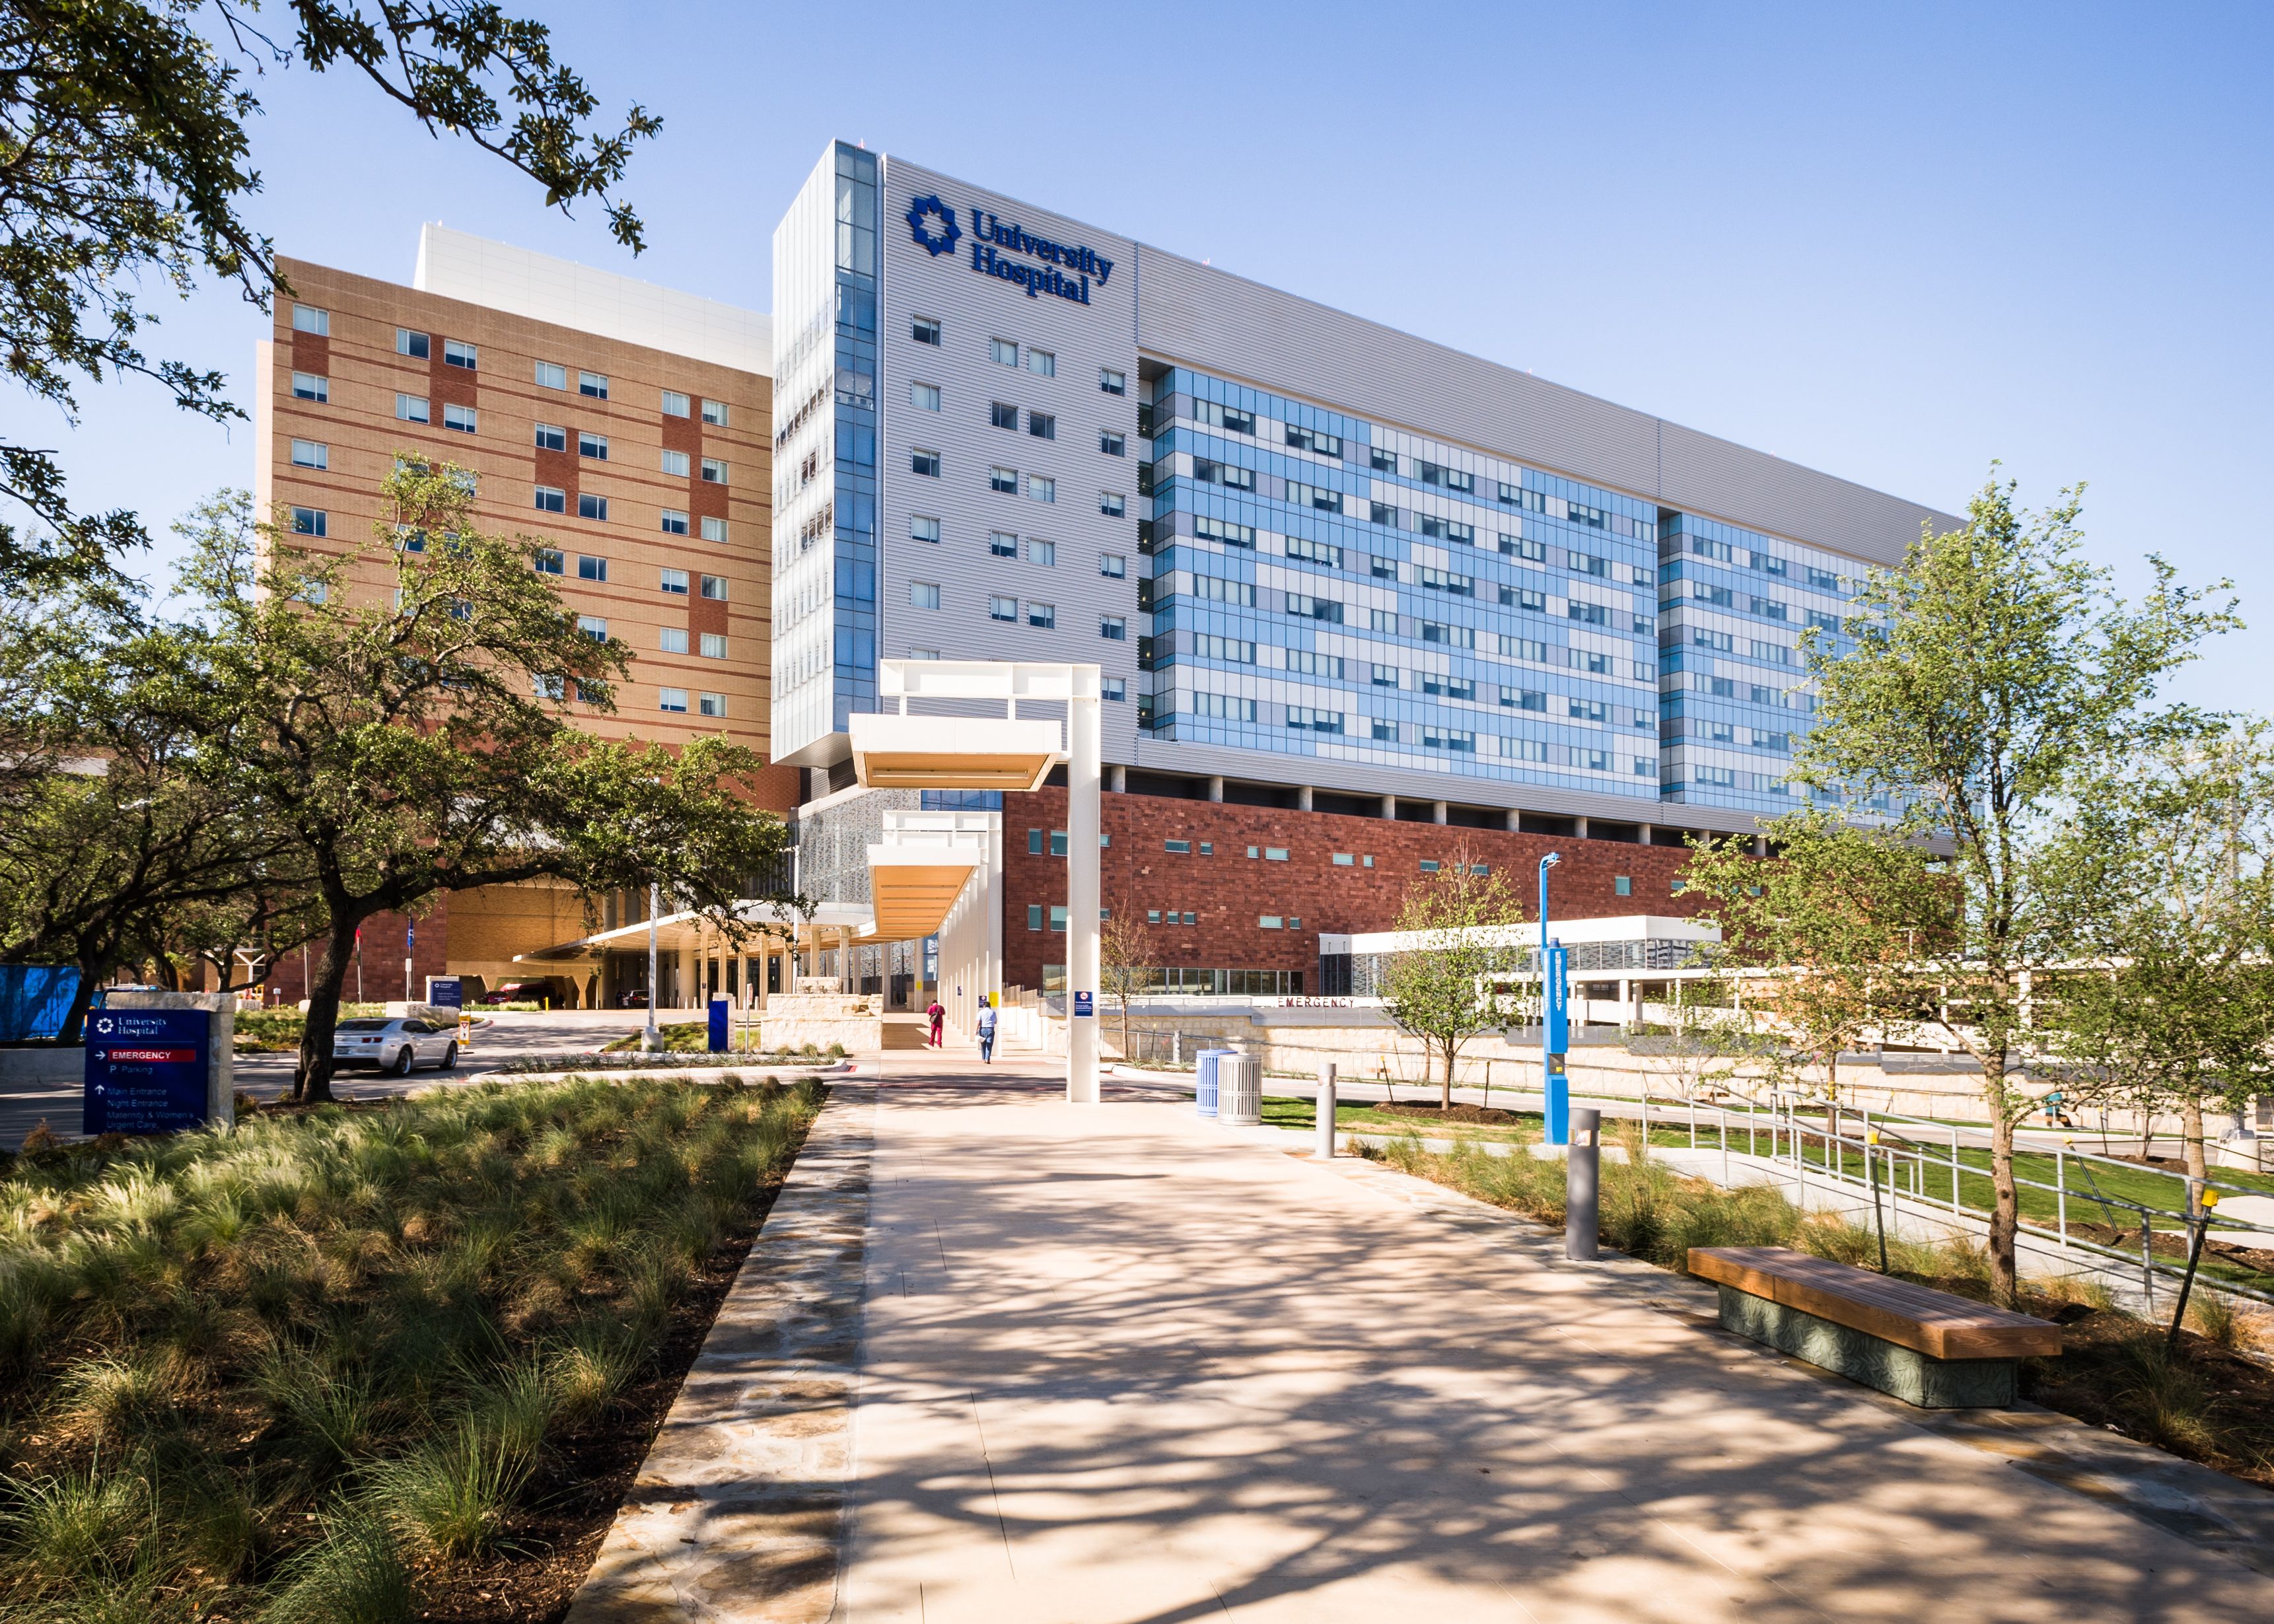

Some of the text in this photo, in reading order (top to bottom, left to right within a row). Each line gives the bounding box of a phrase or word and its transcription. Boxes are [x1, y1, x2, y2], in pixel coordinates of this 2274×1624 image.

[972, 209, 1115, 287] University
[972, 242, 1091, 306] Hospital
[1278, 997, 1355, 1009] EMERGENCY
[118, 1017, 168, 1028] University
[118, 1026, 159, 1037] Hospital
[122, 1065, 153, 1075] Parking
[107, 1100, 129, 1108] Night
[106, 1112, 145, 1120] Maternity
[106, 1121, 135, 1130] Urgent
